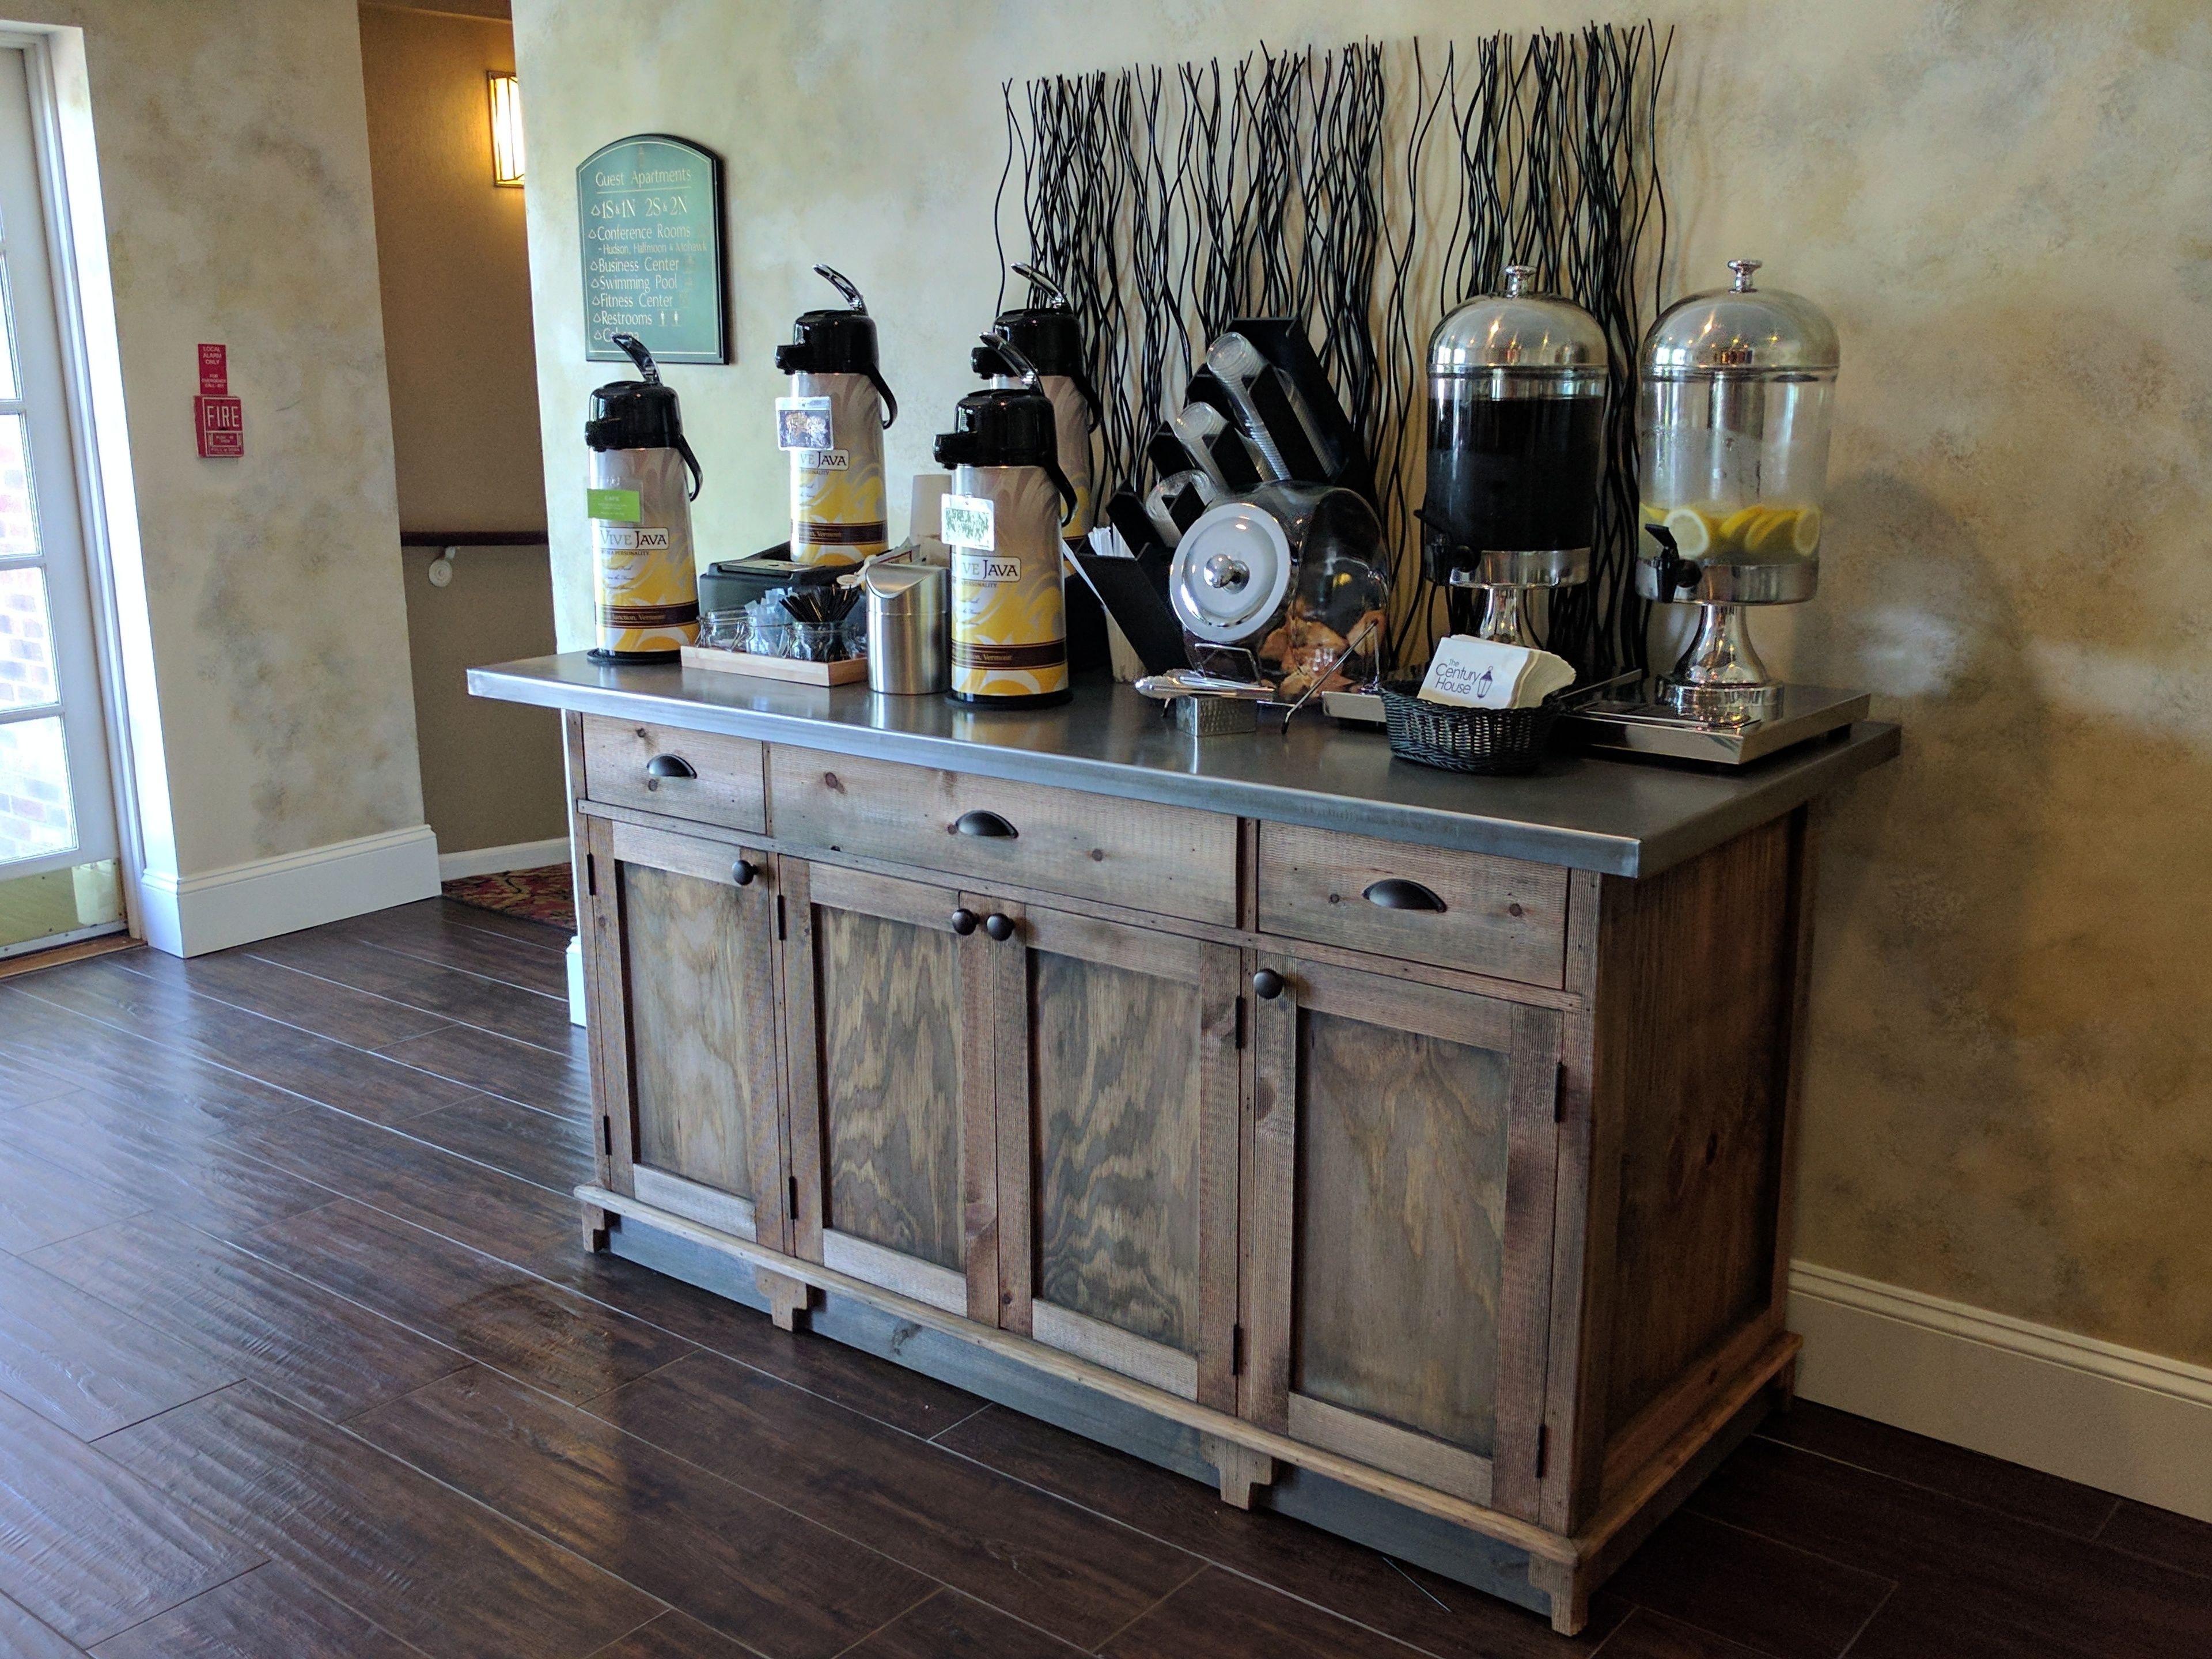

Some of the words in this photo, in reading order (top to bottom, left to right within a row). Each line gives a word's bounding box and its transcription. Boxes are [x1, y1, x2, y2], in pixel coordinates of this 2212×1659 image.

[596, 172, 624, 187] Guest
[631, 168, 691, 188] Apartments
[597, 225, 652, 240] Conference
[657, 223, 691, 238] Rooms
[599, 258, 639, 272] Business
[645, 256, 679, 271] Center
[600, 275, 650, 293] Swimming
[656, 274, 677, 289] Pool
[601, 293, 634, 308] Fitness
[639, 293, 673, 307] Center
[602, 310, 652, 325] Restrooms
[207, 406, 240, 427] FIRE
[817, 451, 847, 468] JAVA
[600, 529, 632, 545] VIVE
[635, 531, 667, 548] JAVA
[983, 559, 1018, 579] JAVA
[1449, 658, 1459, 667] The
[1435, 663, 1481, 685] Century
[1435, 677, 1471, 694] House
